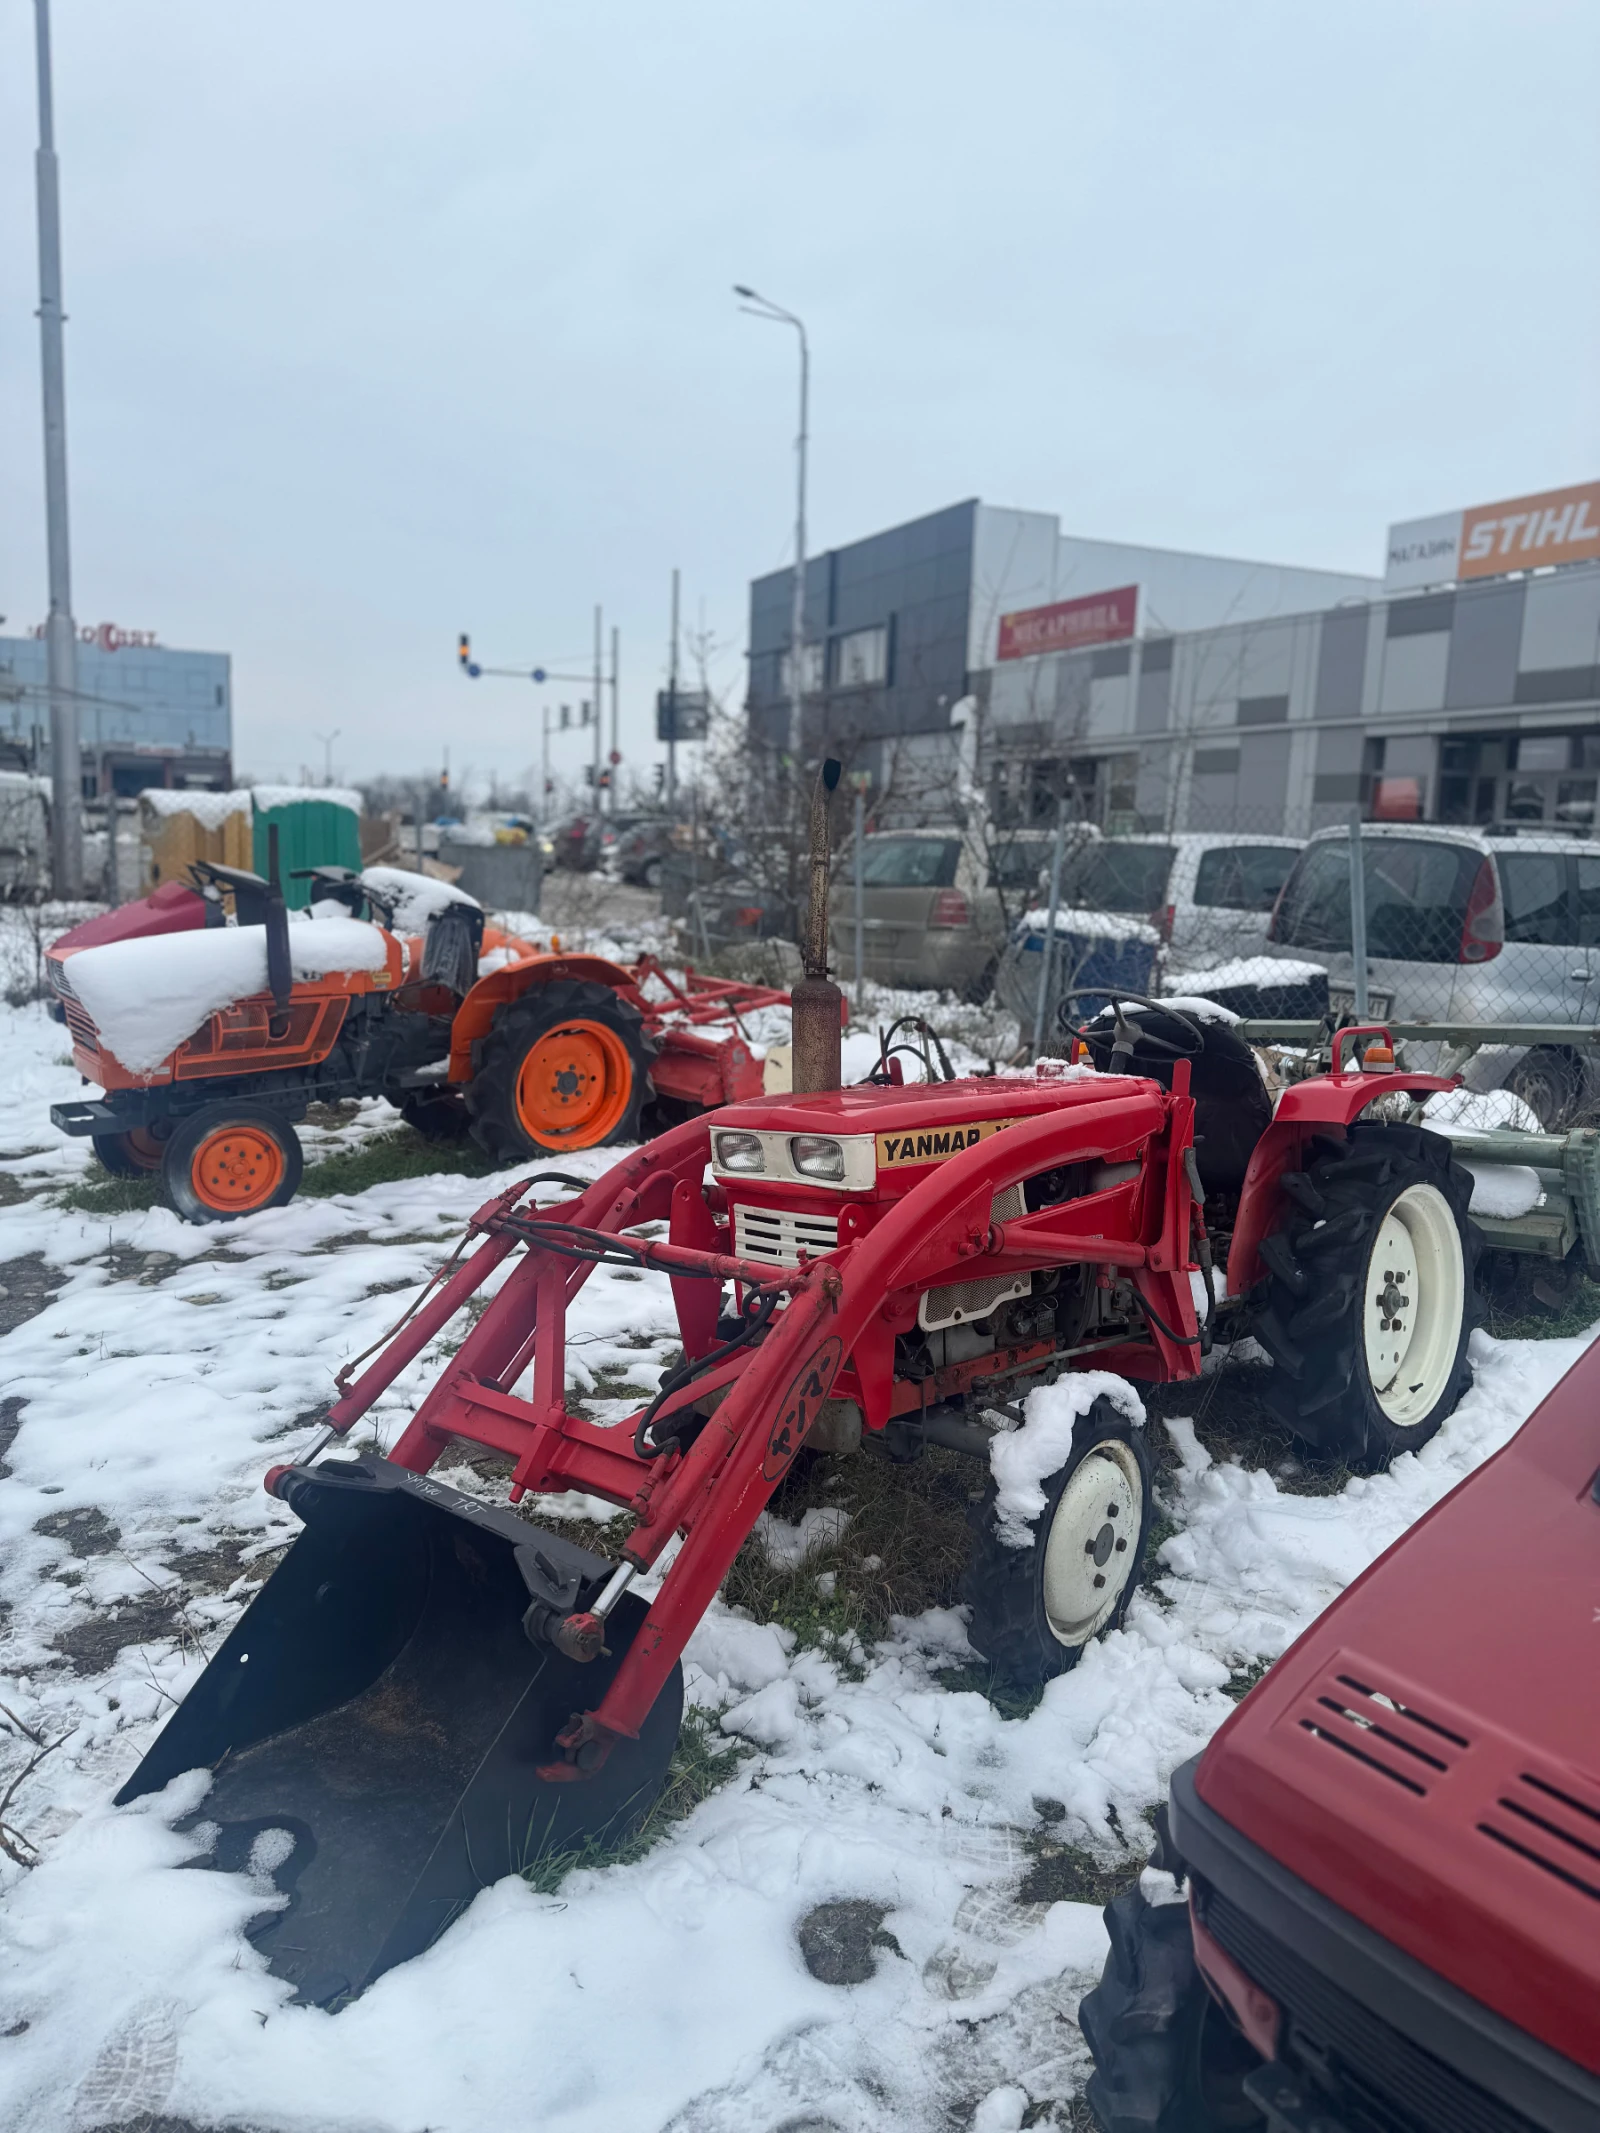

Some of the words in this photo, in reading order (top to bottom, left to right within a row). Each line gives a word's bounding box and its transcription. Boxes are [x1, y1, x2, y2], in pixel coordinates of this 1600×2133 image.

[1463, 500, 1600, 561] STIHL
[771, 1355, 831, 1457] ヤンマー
[452, 1497, 487, 1515] TRT
